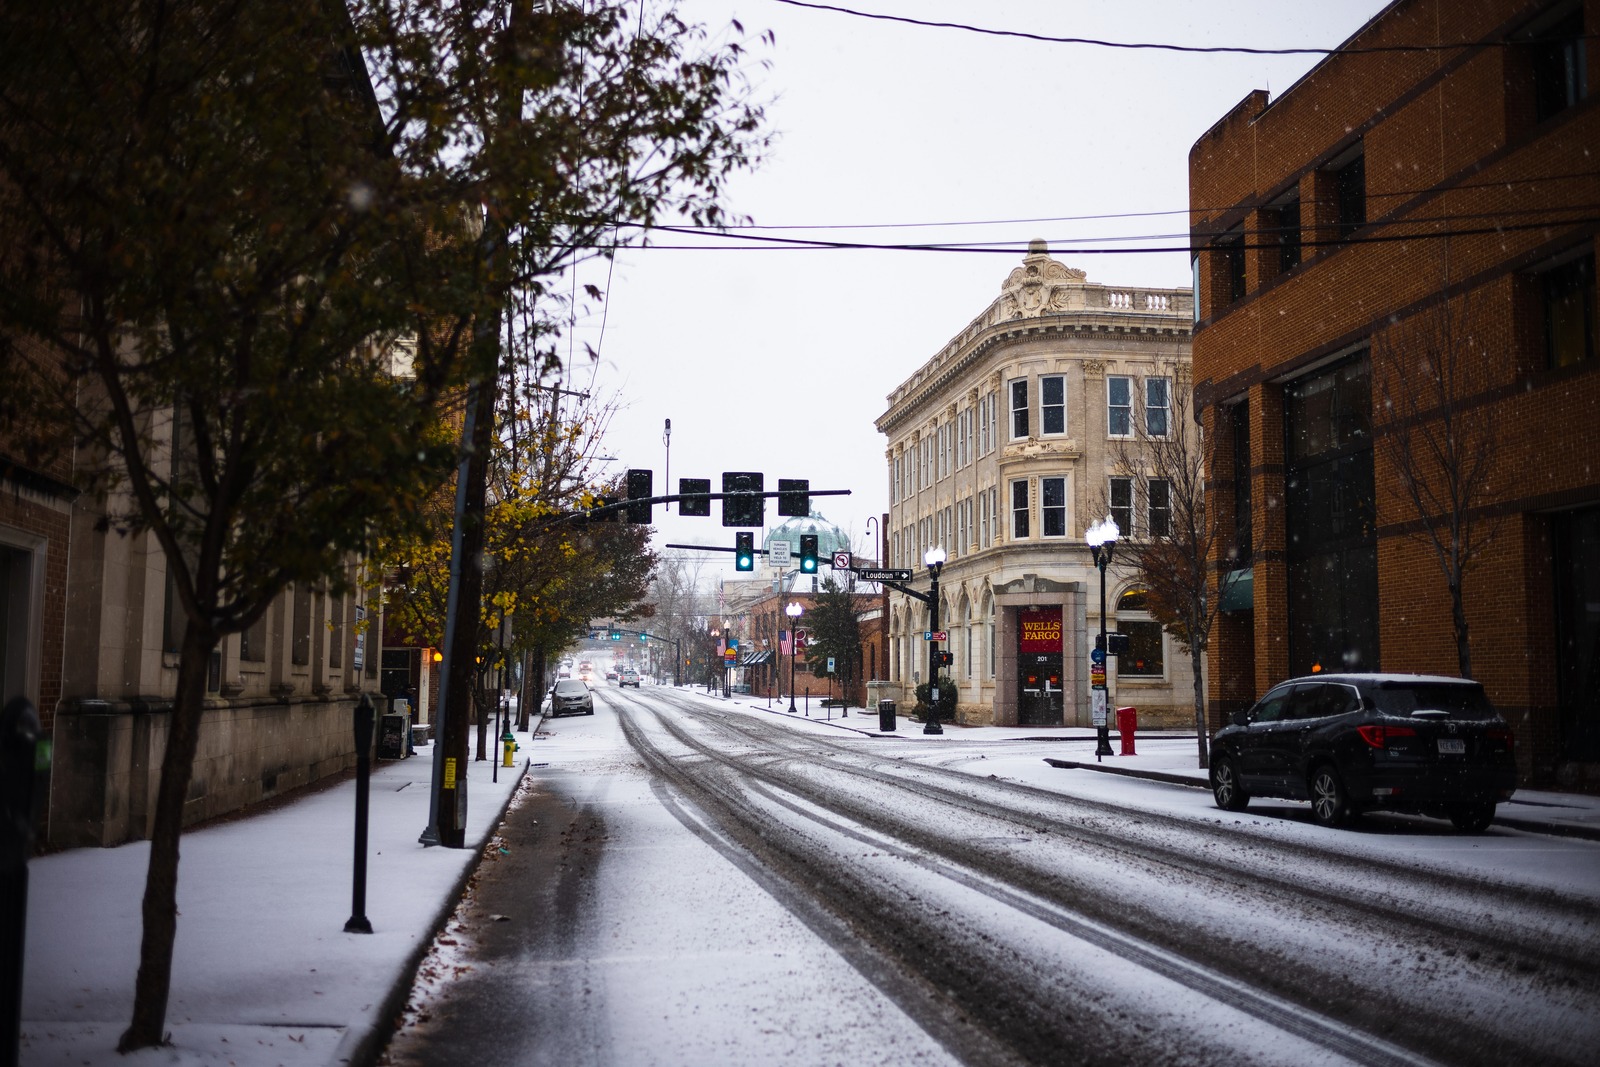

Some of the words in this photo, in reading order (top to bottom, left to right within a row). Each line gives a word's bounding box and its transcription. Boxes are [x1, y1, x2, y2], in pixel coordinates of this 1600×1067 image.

[866, 571, 894, 579] Loudoun
[1023, 621, 1061, 631] WELLS
[925, 632, 932, 640] P
[1024, 631, 1060, 640] FARGO
